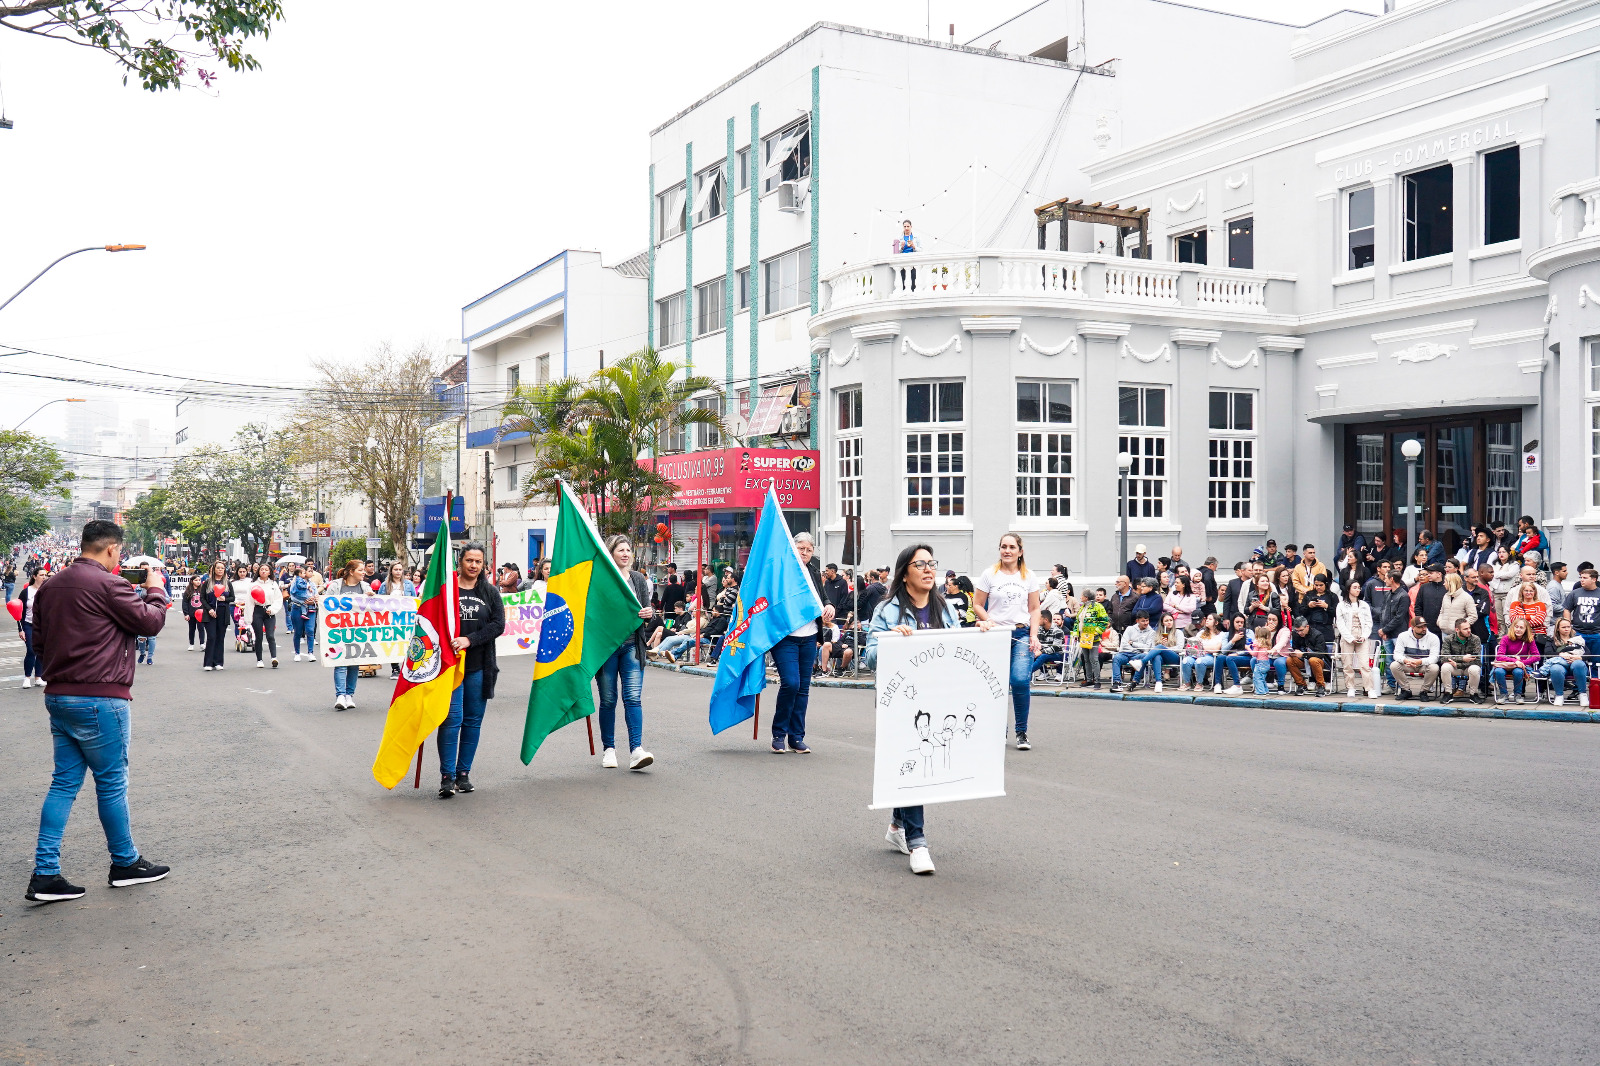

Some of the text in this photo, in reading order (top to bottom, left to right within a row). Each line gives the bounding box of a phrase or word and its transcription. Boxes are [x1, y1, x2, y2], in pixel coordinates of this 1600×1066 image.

[1335, 159, 1373, 182] CLUB
[744, 478, 811, 490] EXCUSIVA
[763, 493, 793, 504] 199
[323, 596, 414, 612] OS VOOS
[1577, 597, 1599, 606] JUST
[325, 611, 417, 628] CRIAM ME
[518, 605, 542, 620] NO
[327, 626, 414, 644] SUSTENT
[344, 641, 410, 659] DA VI
[880, 642, 1004, 707] EMEI VOVÔ BENJAMIN
